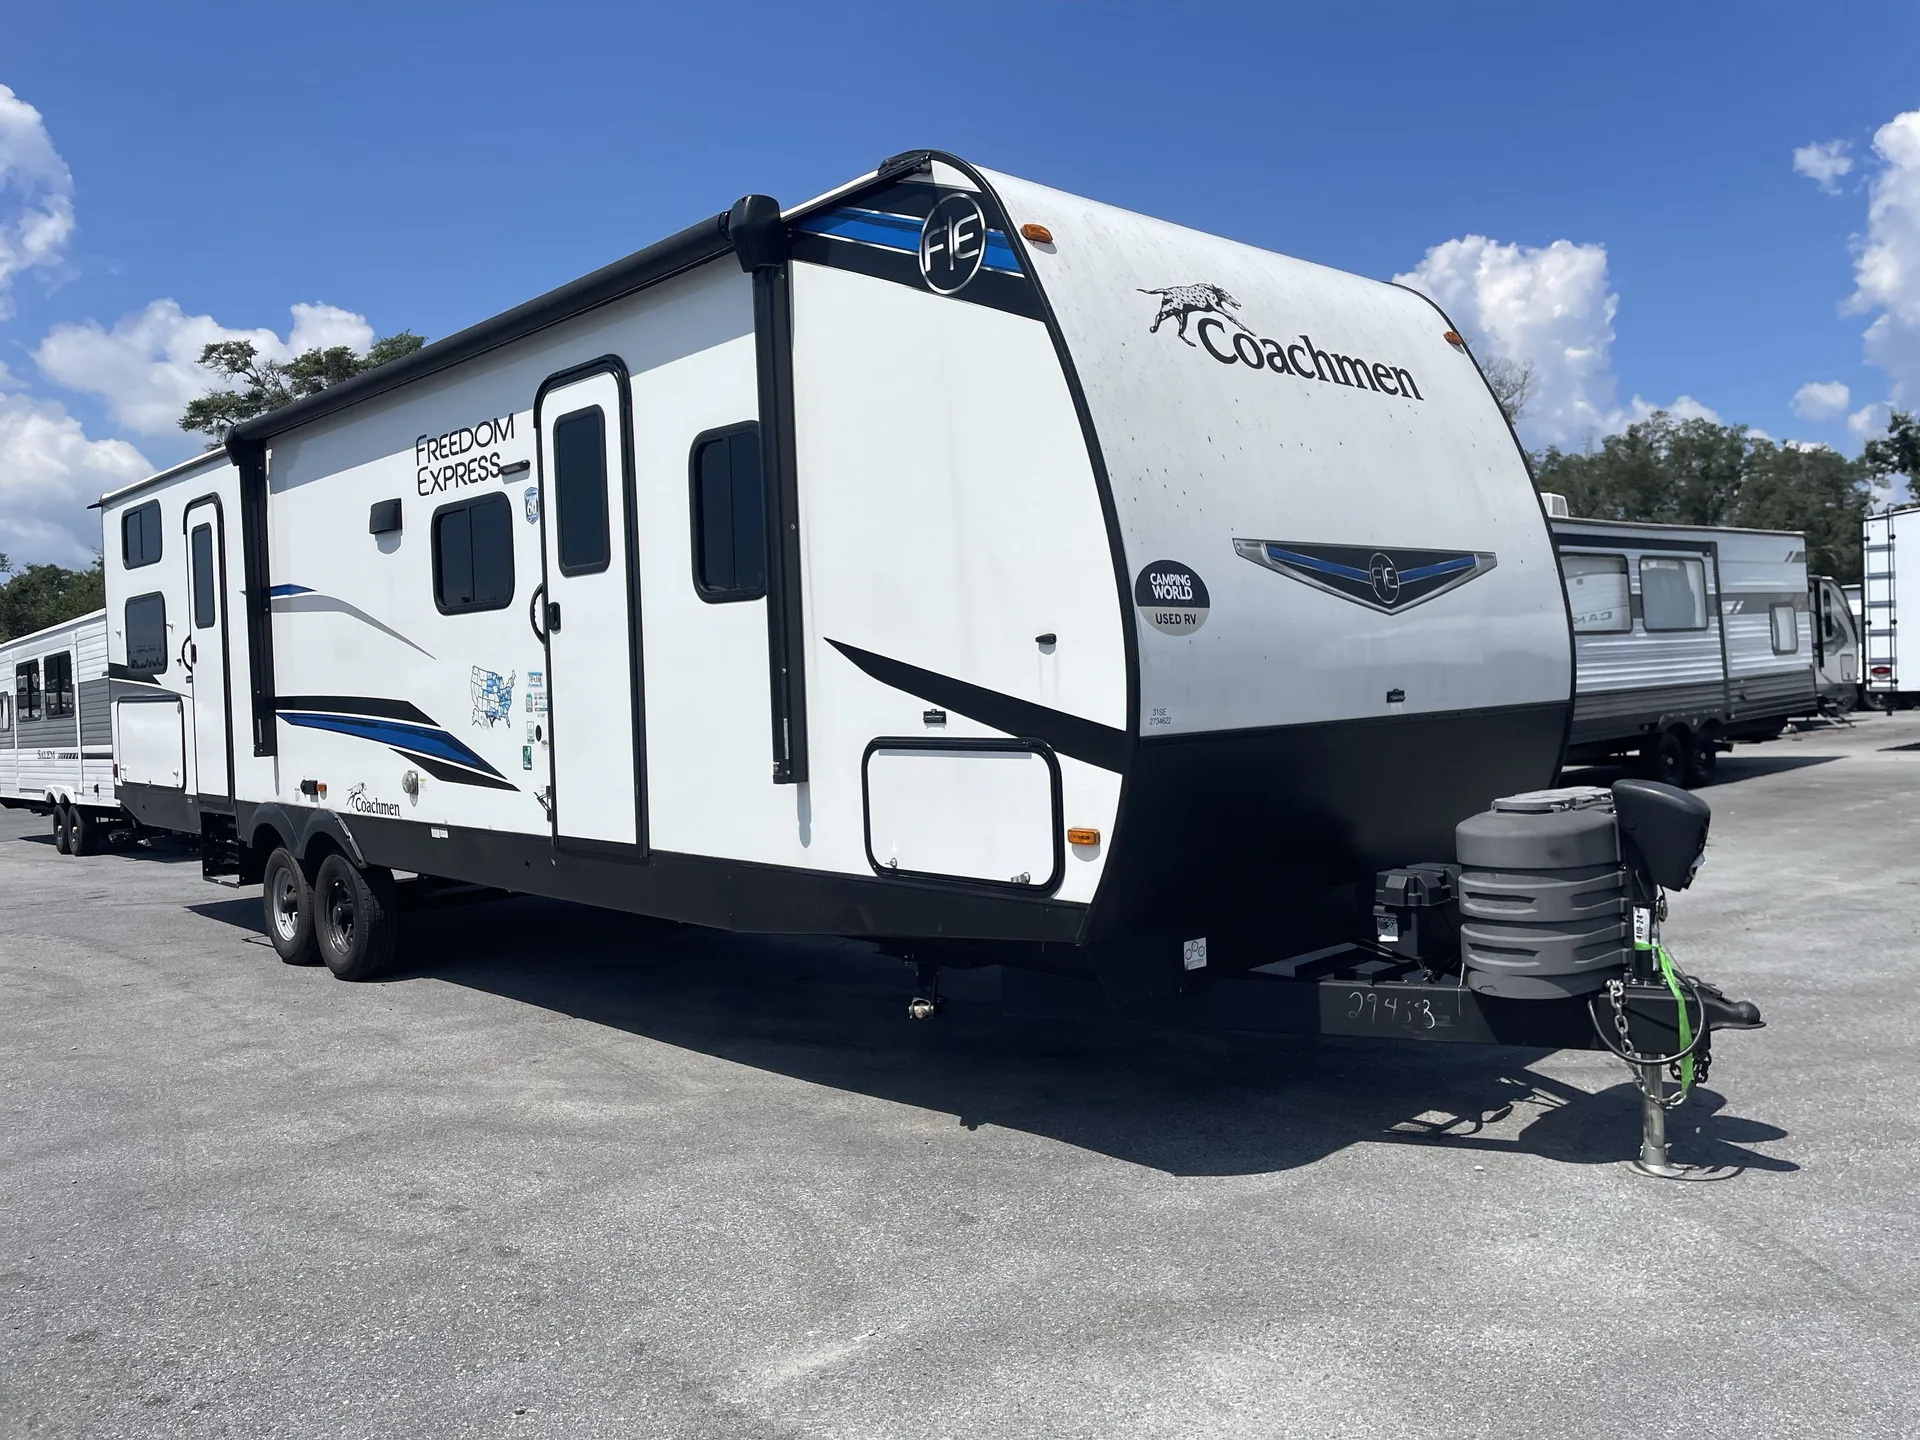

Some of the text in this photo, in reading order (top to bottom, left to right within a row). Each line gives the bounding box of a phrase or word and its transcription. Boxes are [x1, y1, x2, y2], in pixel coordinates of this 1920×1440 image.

[1197, 318, 1424, 400] Coachmen
[415, 412, 515, 466] FREEDOM
[417, 452, 502, 497] EXPRESS
[1150, 573, 1191, 587] CAMPING
[1152, 585, 1193, 600] WORLD
[1155, 613, 1197, 625] USED RV
[1153, 708, 1167, 716] 31SE
[37, 750, 55, 759] SALEM
[355, 798, 401, 816] Coachmen
